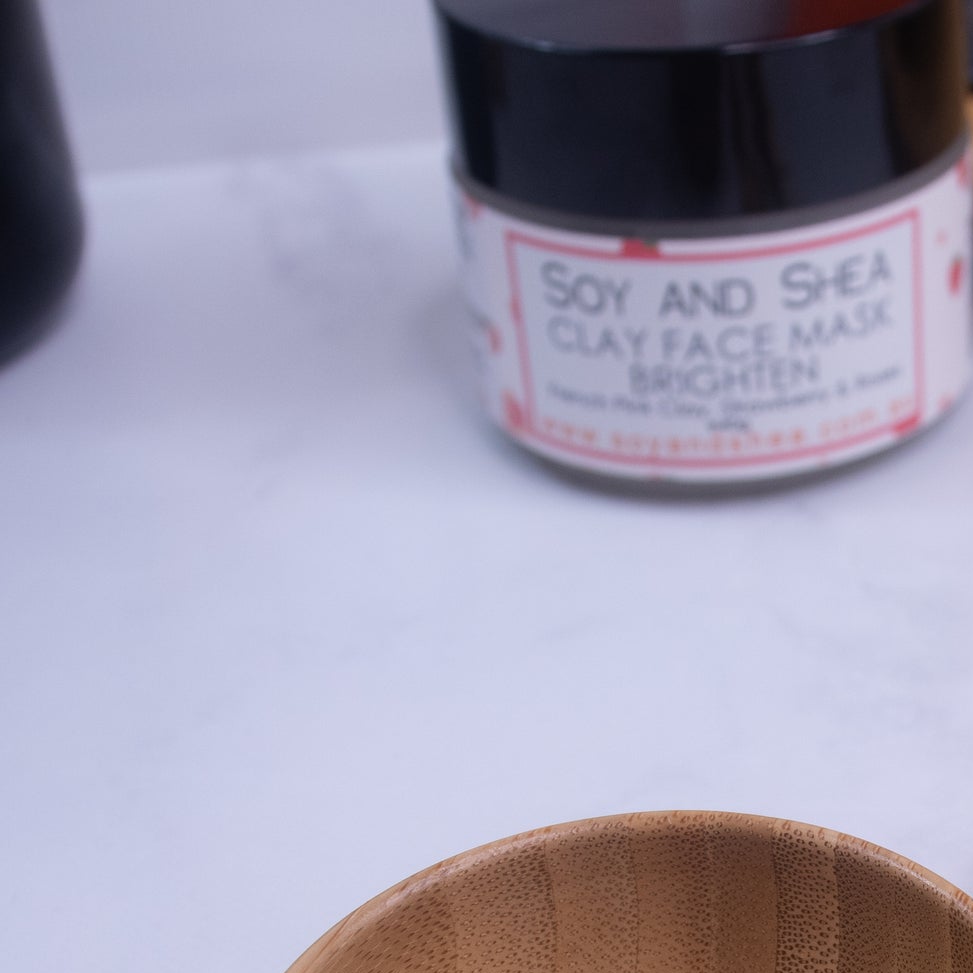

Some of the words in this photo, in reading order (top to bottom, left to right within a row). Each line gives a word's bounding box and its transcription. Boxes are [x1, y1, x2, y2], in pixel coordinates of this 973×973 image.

[540, 259, 631, 317] SOY
[657, 276, 755, 319] AND
[780, 249, 893, 312] SHEA
[545, 316, 648, 361] CLAY
[661, 324, 774, 364] FACE
[788, 301, 894, 353] MASK
[627, 359, 818, 396] BRIGHTEN
